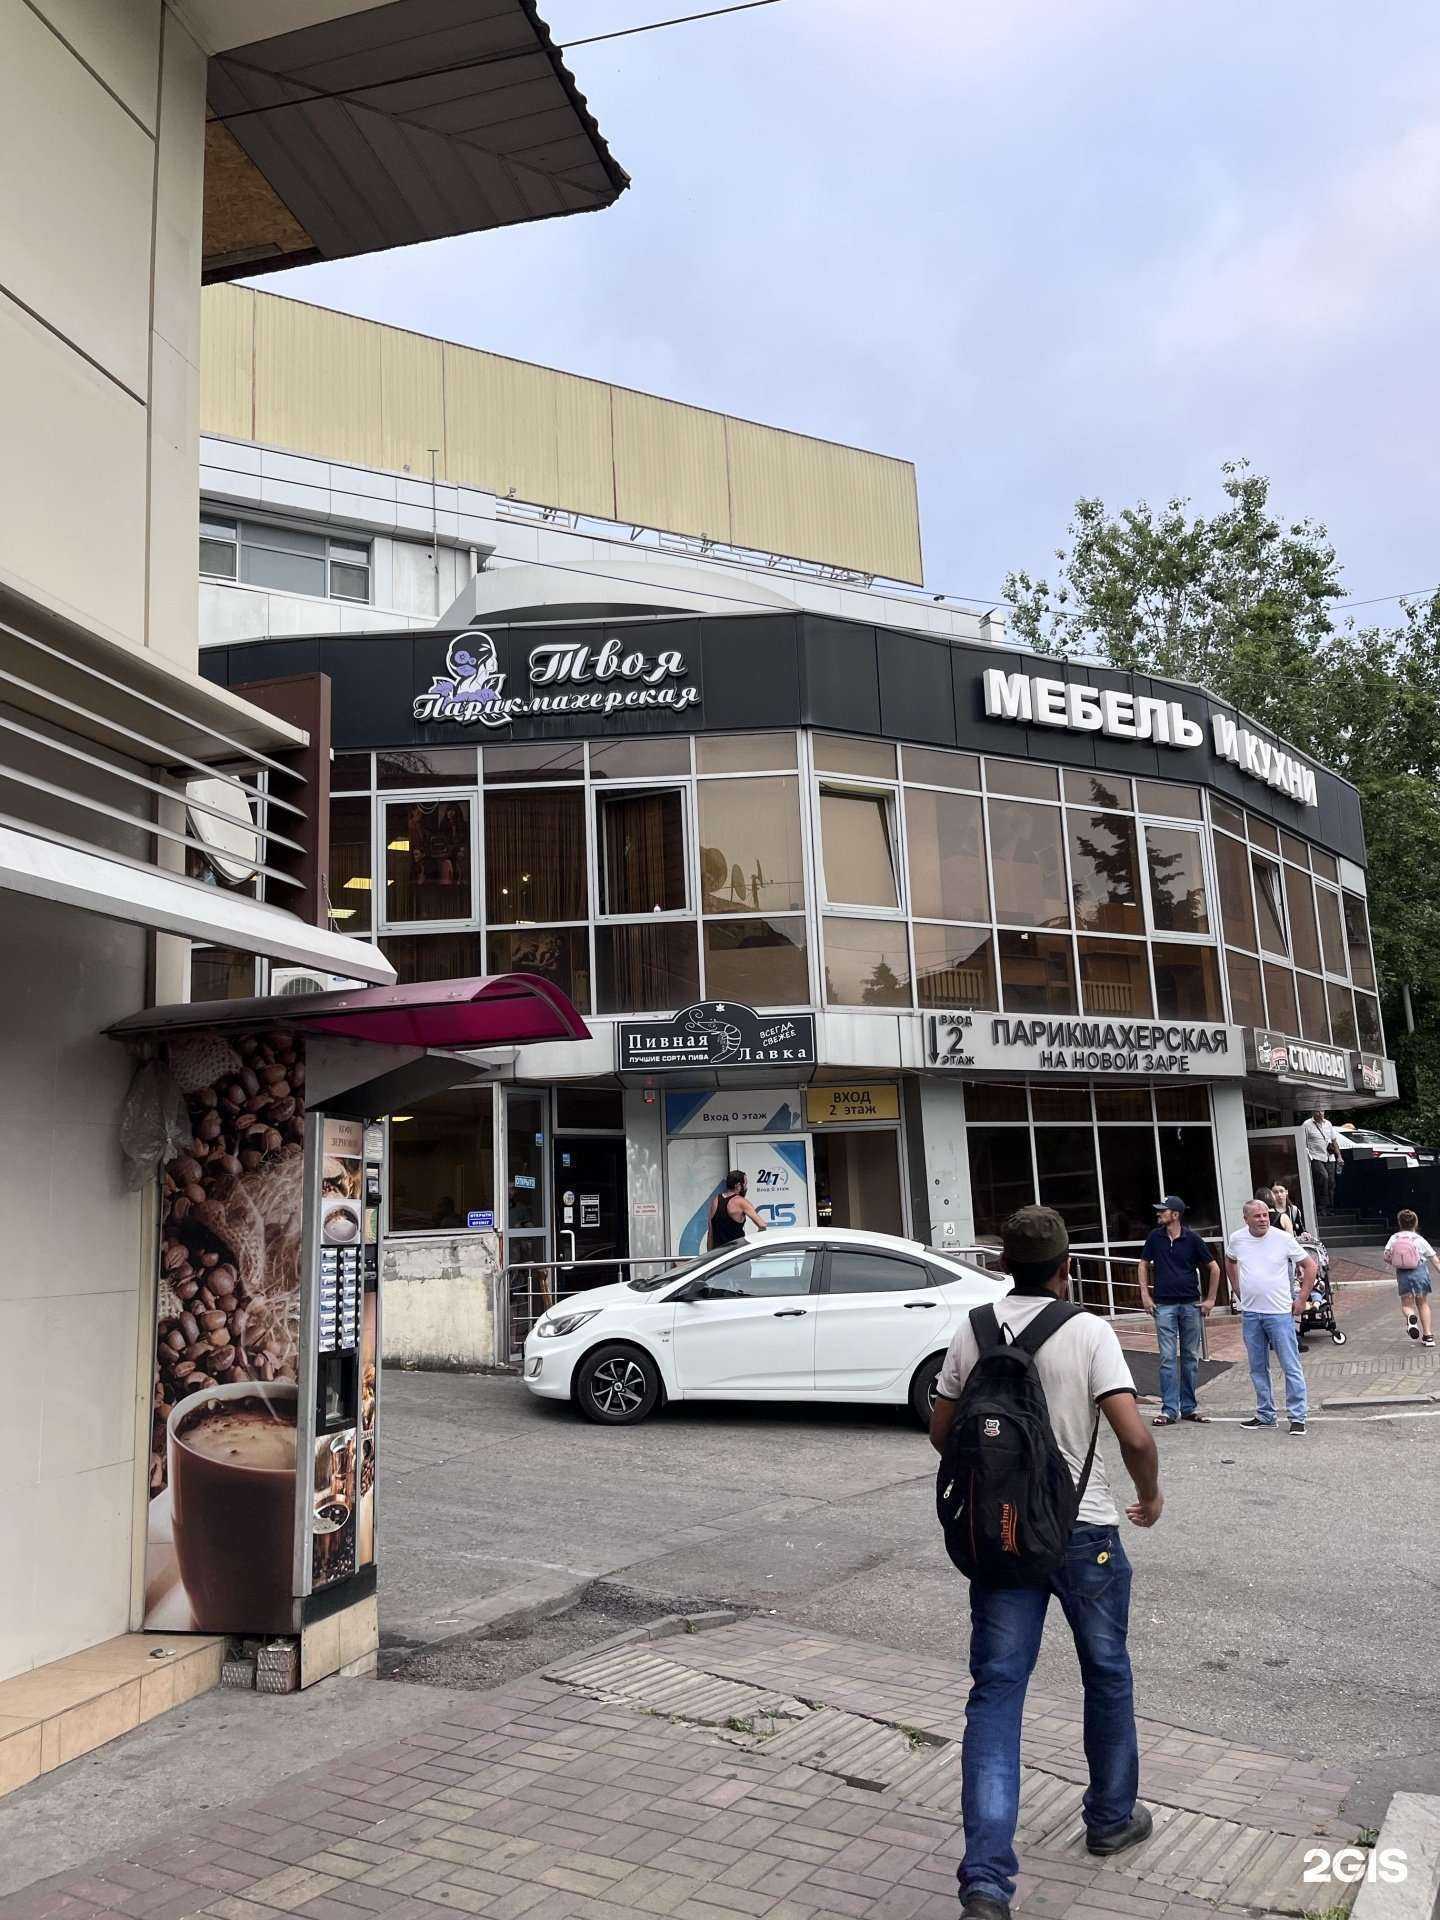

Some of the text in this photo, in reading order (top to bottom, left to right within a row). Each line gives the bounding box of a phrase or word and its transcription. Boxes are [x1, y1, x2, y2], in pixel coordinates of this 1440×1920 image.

[529, 640, 686, 684] Твоя
[413, 687, 700, 721] Парикмахерская
[983, 669, 1203, 748] МЕБЕЛЬ
[940, 1015, 972, 1026] ВХОД
[760, 1021, 794, 1039] ВСЕГДА
[763, 1030, 797, 1047] СВЕЖЕЕ
[991, 1019, 1229, 1053] ПАРИКМАХЕРСКАЯ
[628, 1034, 708, 1048] Пивная
[947, 1027, 964, 1054] 2
[629, 1055, 660, 1063] ЛУЧШИЕ
[738, 1048, 806, 1061] Лавка
[940, 1055, 975, 1065] ЭТАЖ
[1040, 1050, 1190, 1072] НА НОВОЙ ЗАРЕ
[1288, 1045, 1346, 1079] СТОЛОВАЯ
[833, 1091, 871, 1104] ВХОД
[703, 1111, 767, 1122] Вход 0 этаж
[829, 1104, 877, 1115] 2 этаж
